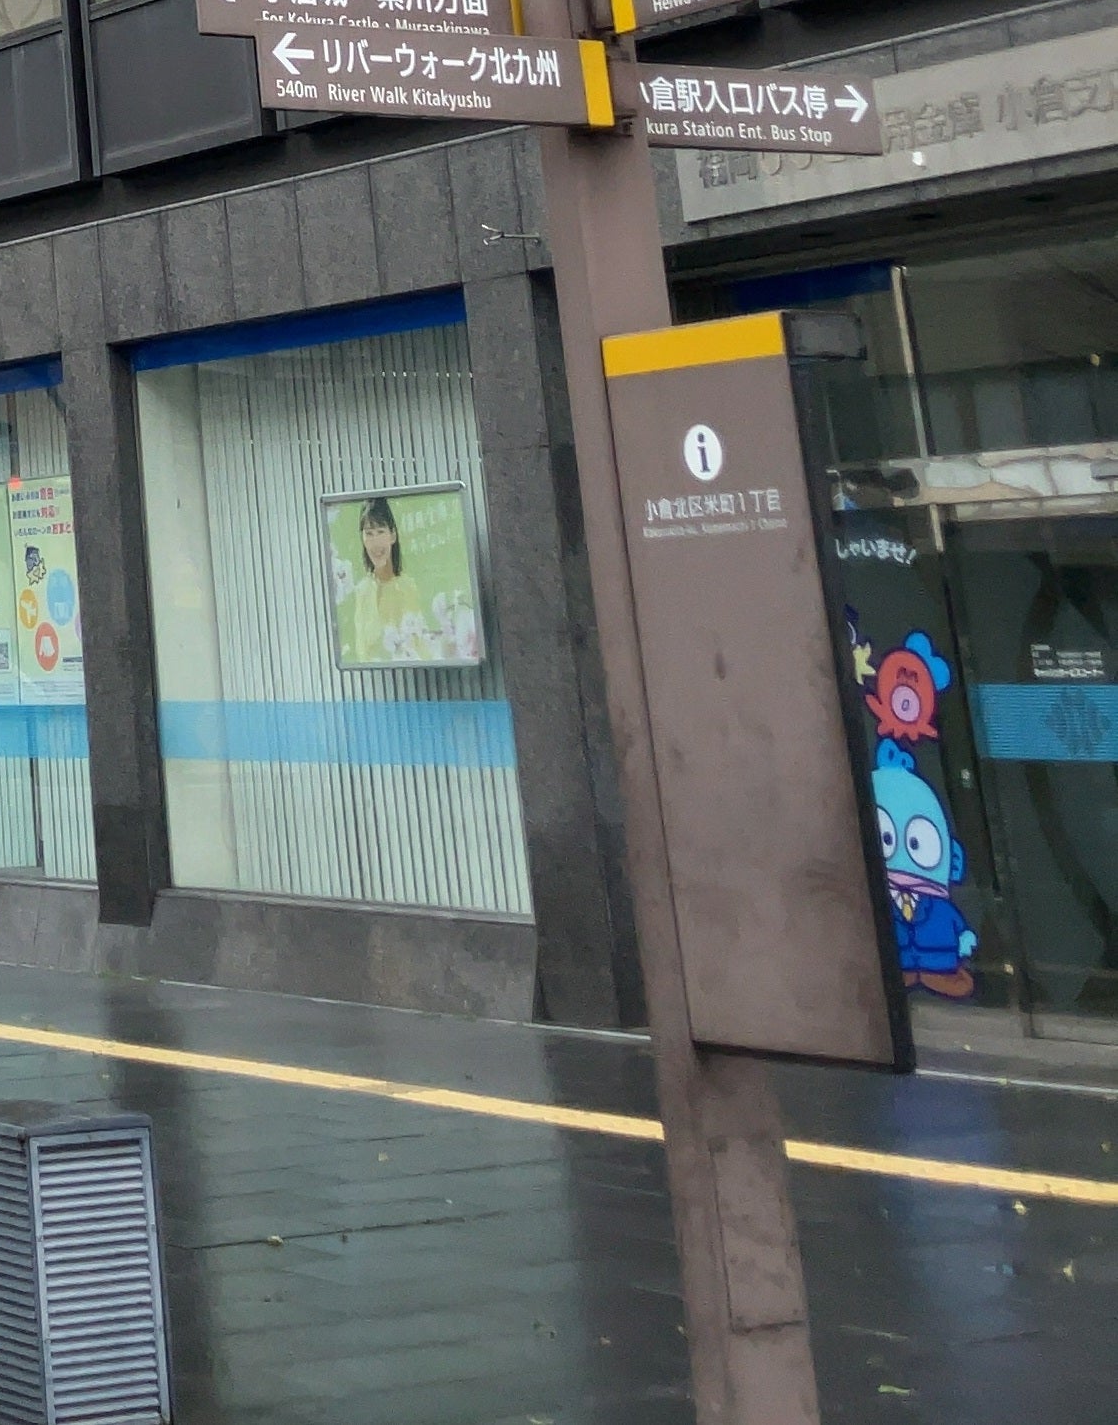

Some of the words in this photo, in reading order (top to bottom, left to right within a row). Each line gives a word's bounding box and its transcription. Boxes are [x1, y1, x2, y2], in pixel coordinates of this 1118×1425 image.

[322, 38, 561, 87] リバーウォーク北九州
[276, 79, 317, 99] 540m
[328, 84, 366, 103] River
[370, 86, 408, 105] Walk
[413, 88, 491, 111] Kitakyushu
[640, 76, 829, 120] 倉駅入口バス停
[645, 118, 679, 136] kura
[682, 121, 734, 138] Station
[738, 123, 767, 140] Ent.
[771, 124, 796, 141] Bus
[800, 127, 833, 146] Stop
